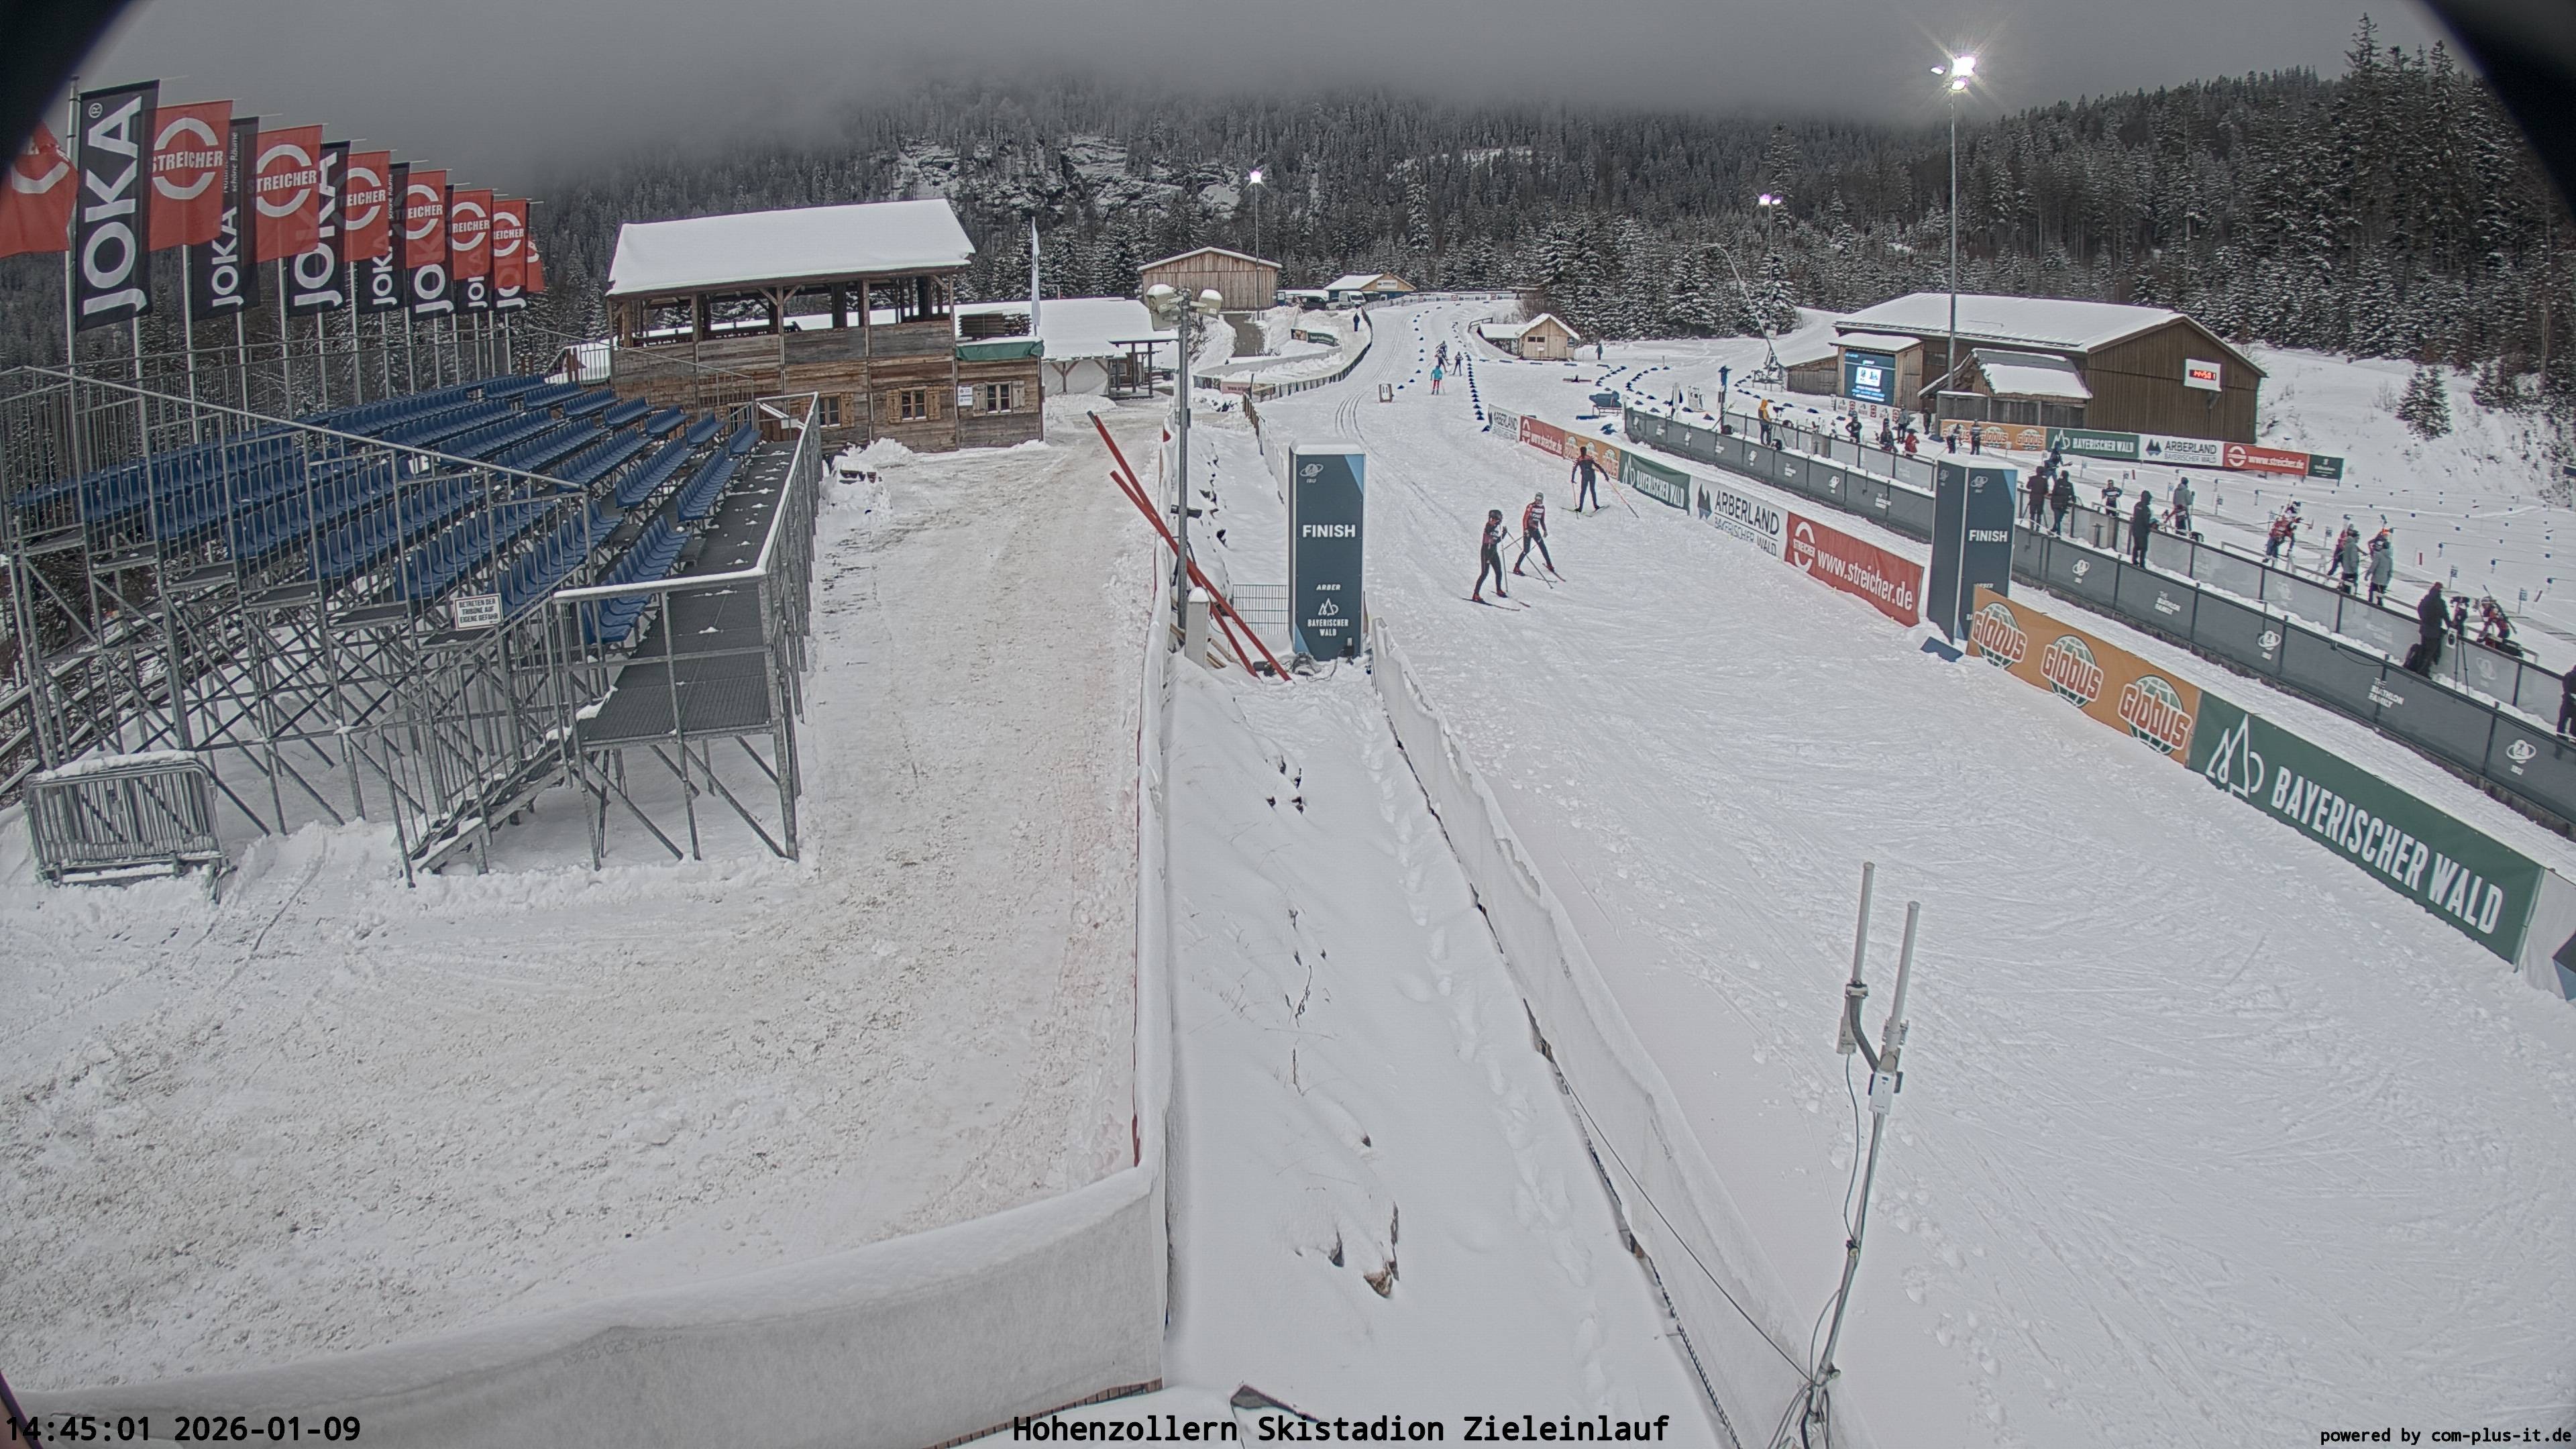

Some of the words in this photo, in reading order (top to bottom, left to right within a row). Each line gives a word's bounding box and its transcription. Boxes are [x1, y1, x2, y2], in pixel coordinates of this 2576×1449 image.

[453, 219, 490, 233] REICHER
[212, 206, 244, 307] JOKA
[2073, 438, 2114, 451] BAYERISCHER
[2116, 440, 2134, 453] WALD
[2164, 440, 2217, 455] ARBERLAND
[1715, 490, 1780, 535] ARBERLAND
[1302, 525, 1356, 538] FINISH
[1968, 529, 2008, 543] FINISH
[1756, 535, 1777, 557] WALD
[1817, 549, 1913, 611] www.streicher.de
[1307, 619, 1349, 627] BAYERISCHER
[1319, 628, 1337, 637] WALD
[2271, 766, 2430, 892] BAYERISCHER
[2428, 852, 2503, 934] WALD
